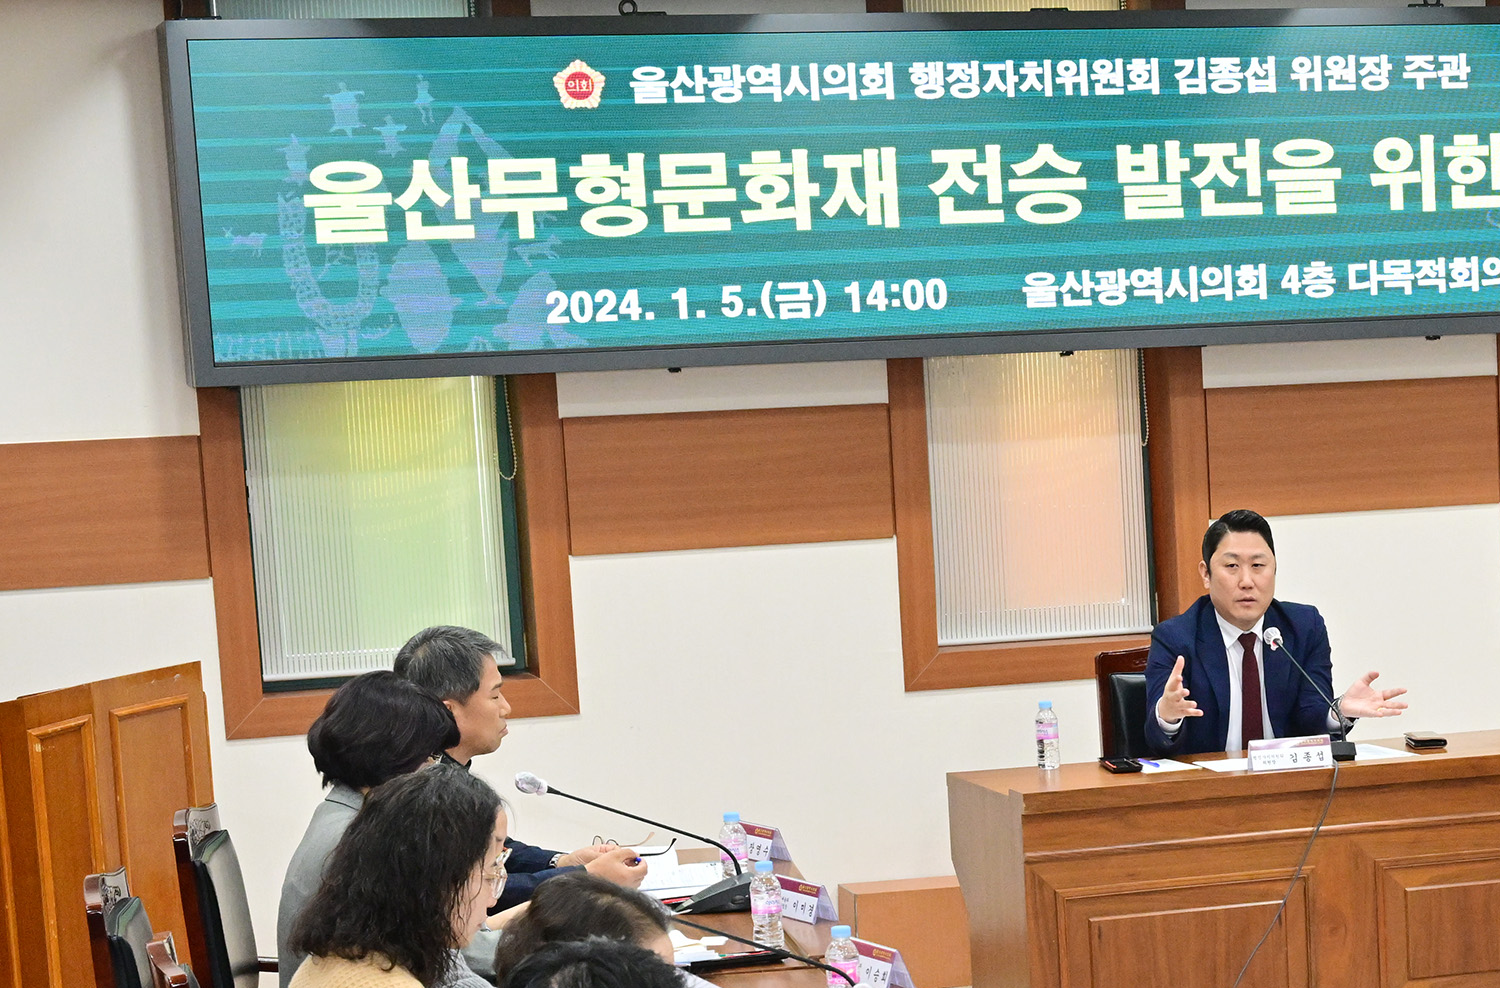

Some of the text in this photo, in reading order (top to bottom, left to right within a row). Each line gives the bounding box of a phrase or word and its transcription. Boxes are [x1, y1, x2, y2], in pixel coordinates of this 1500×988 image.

[567, 79, 592, 92] 의회
[629, 53, 1471, 105] 울산광역시의회 행정자치위원회 김종섭 위원장 주관
[303, 146, 900, 244] 울산무형문화재
[927, 140, 1087, 226] 전승
[1115, 137, 1342, 221] 발전을
[545, 278, 948, 325] 2024. 1. 5.(금) 14:00
[1022, 263, 1268, 309] 울산광역시의회
[1280, 260, 1337, 299] 4층
[1290, 750, 1324, 763] 김종섭
